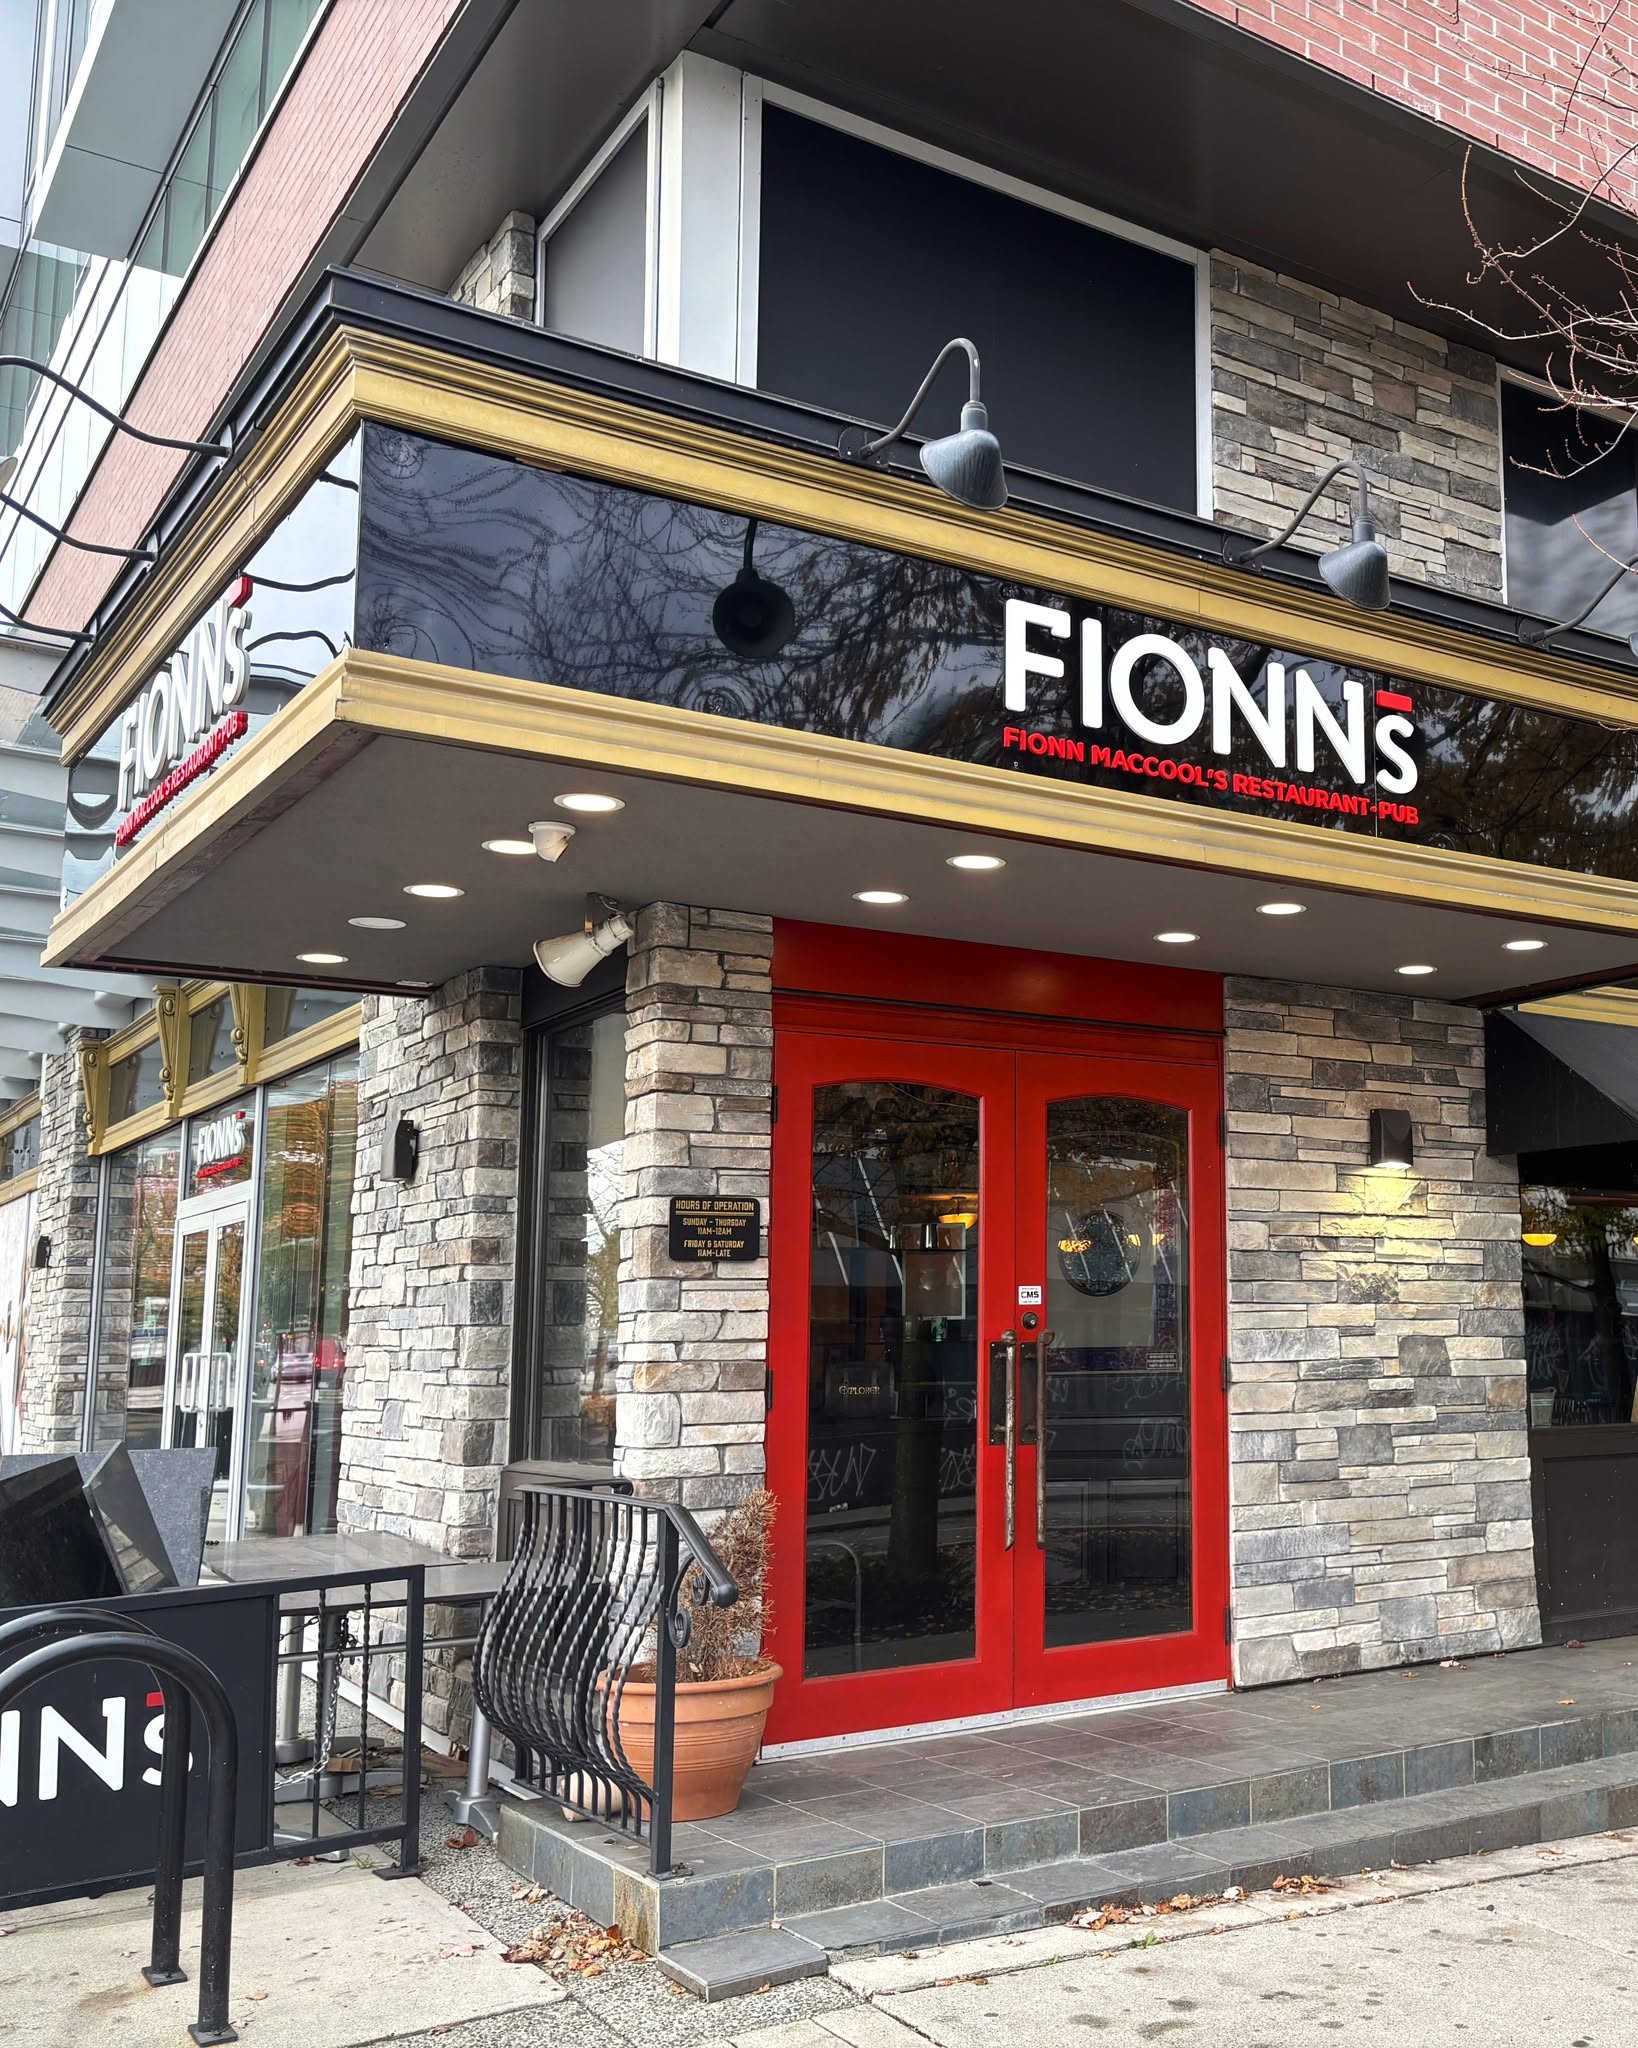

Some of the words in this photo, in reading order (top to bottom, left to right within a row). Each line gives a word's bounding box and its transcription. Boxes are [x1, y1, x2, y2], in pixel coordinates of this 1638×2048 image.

[1003, 726, 1084, 763] FIONN
[1090, 744, 1229, 792] MACCOOL'S
[675, 1200, 700, 1210] HOURS
[702, 1201, 712, 1211] OF
[714, 1201, 754, 1211] OPERATION
[683, 1218, 707, 1226] SUNDAY
[715, 1218, 746, 1227] THURSDAY
[683, 1240, 705, 1248] FRIDAY
[713, 1240, 744, 1249] SATURDAY
[1021, 1291, 1039, 1299] CMS
